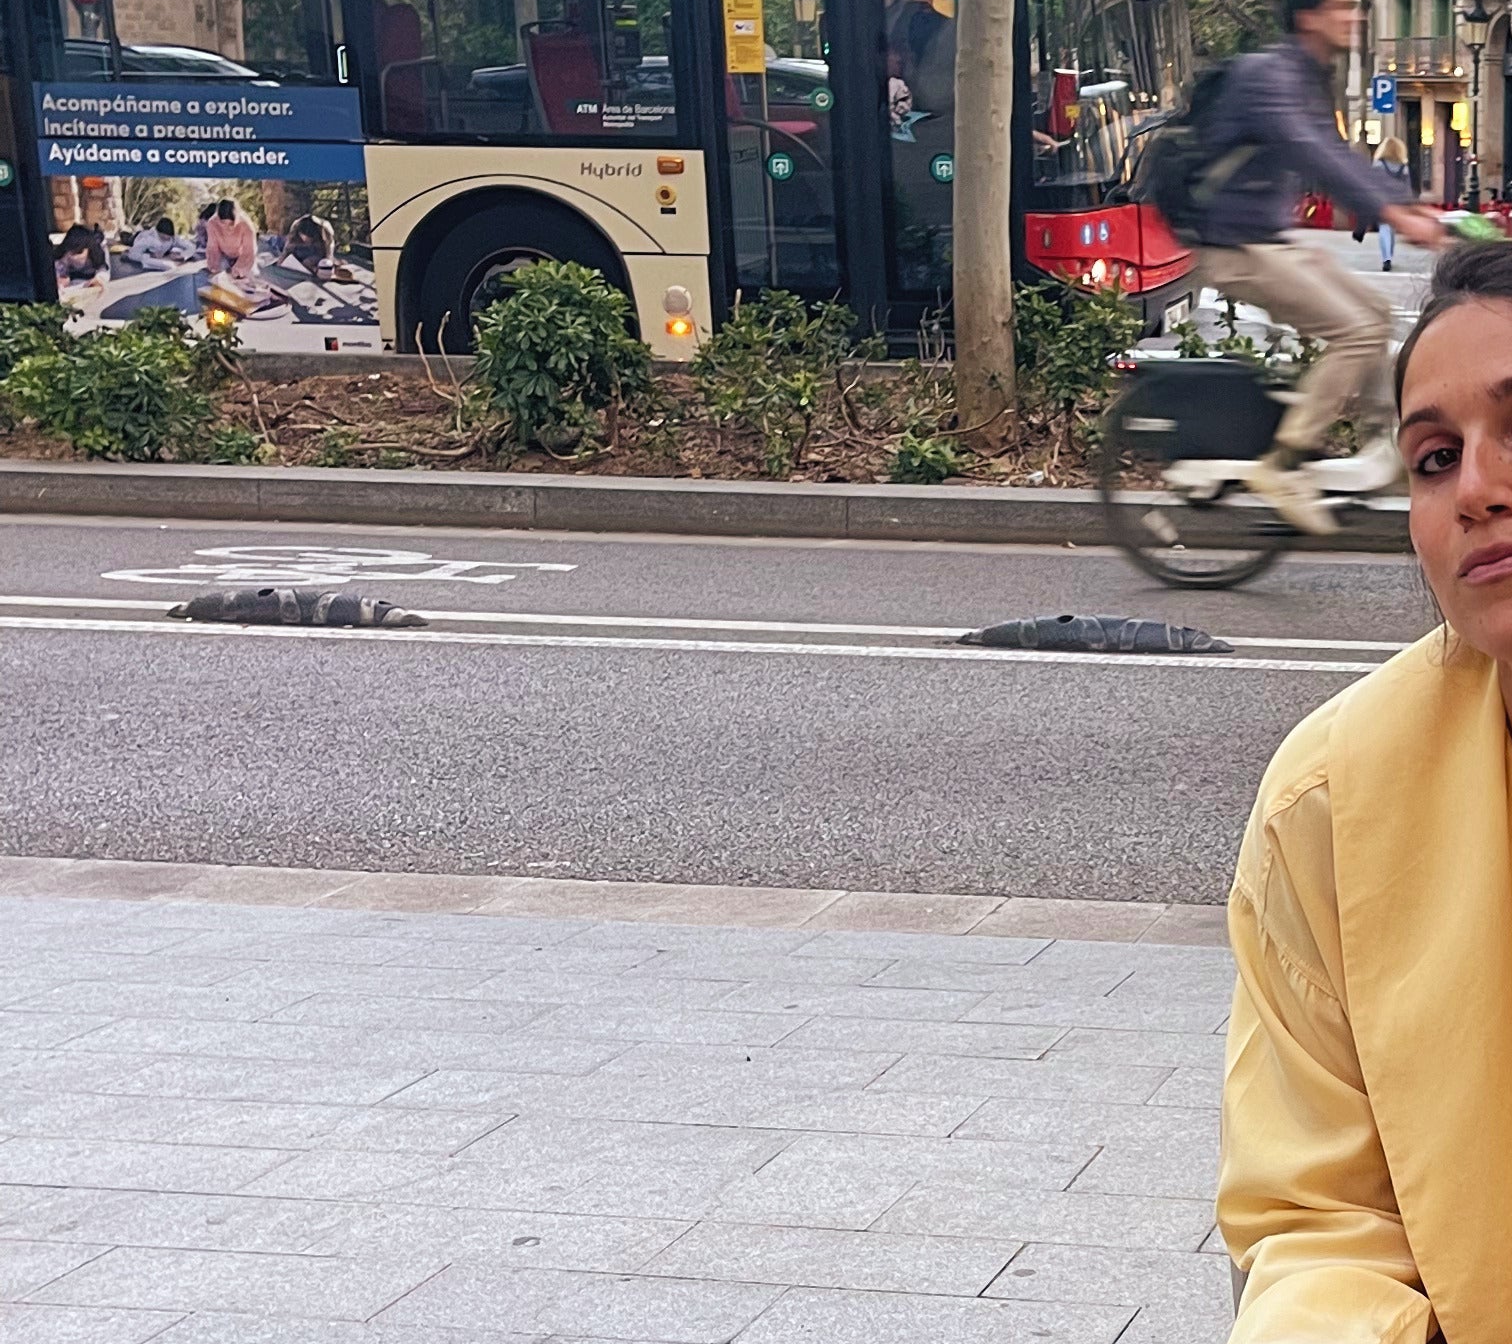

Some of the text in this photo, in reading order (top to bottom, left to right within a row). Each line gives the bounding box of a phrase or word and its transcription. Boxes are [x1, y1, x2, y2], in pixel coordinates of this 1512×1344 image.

[1376, 79, 1392, 99] P
[42, 93, 293, 119] Acompáñame a explorar.
[576, 104, 598, 114] ATM
[44, 118, 130, 138] Incítame
[135, 124, 149, 138] a
[49, 142, 290, 168] Ayúdame a comprender.
[580, 162, 643, 180] Hybrid
